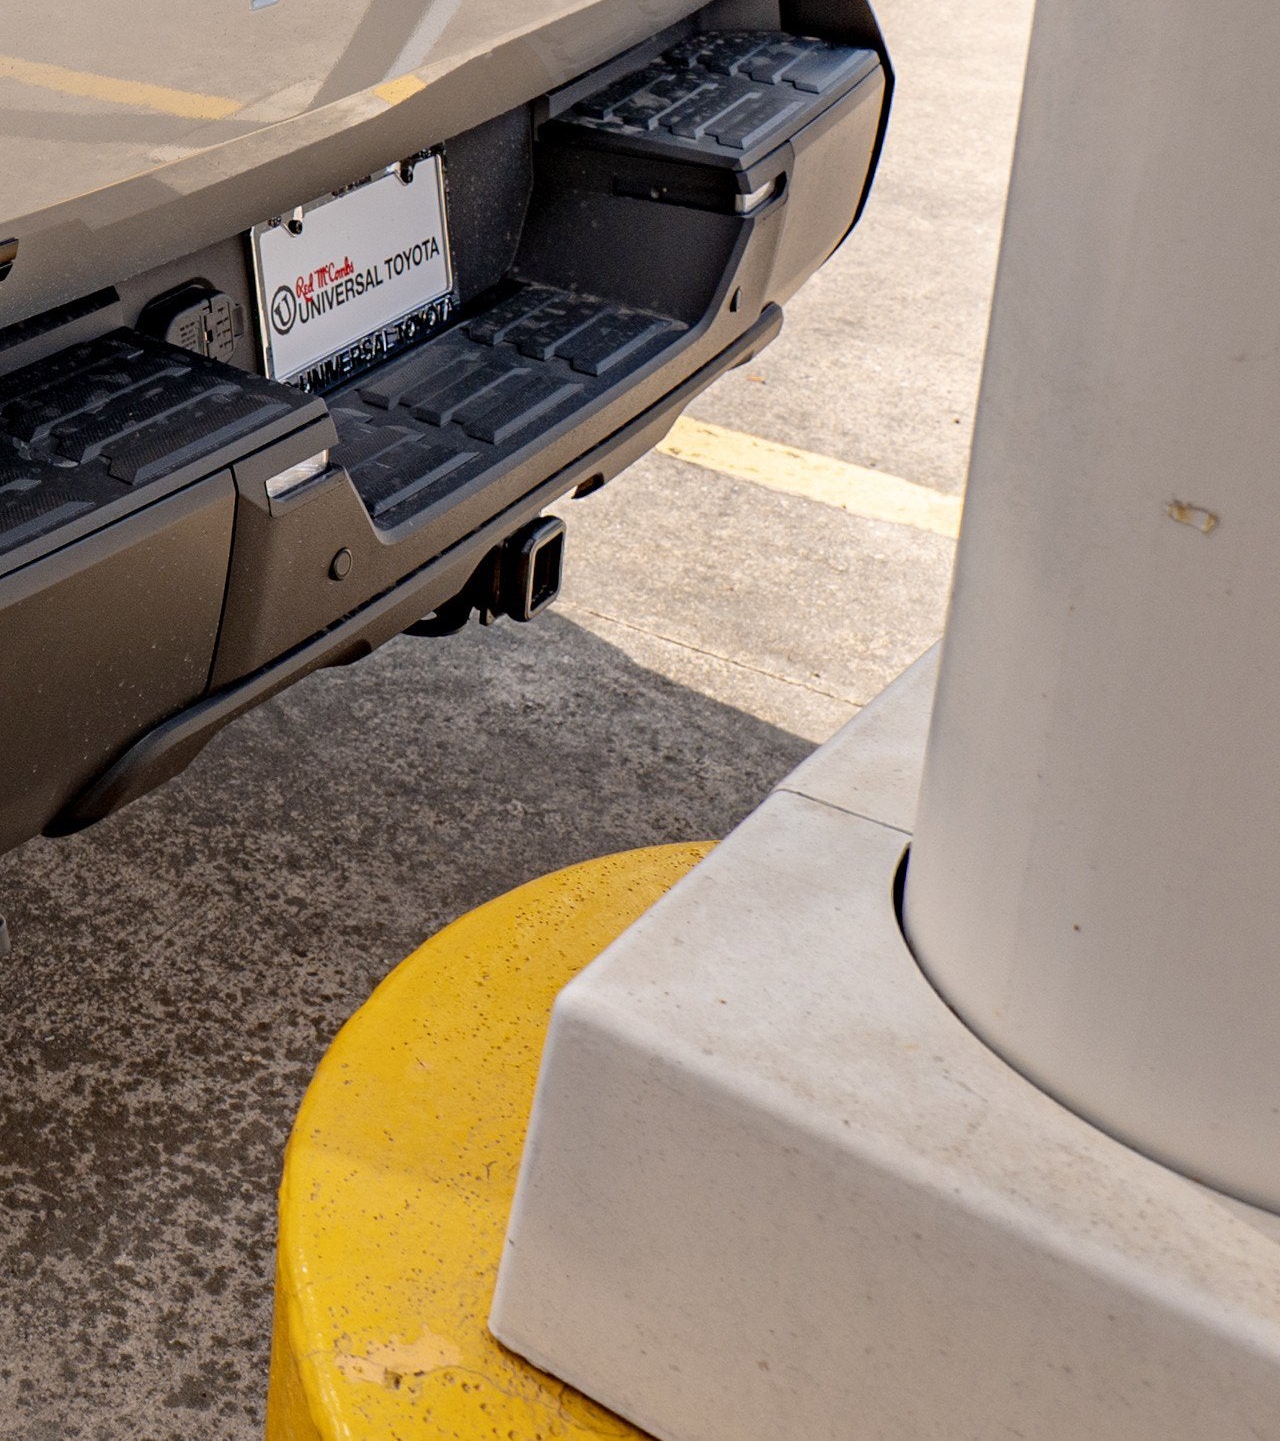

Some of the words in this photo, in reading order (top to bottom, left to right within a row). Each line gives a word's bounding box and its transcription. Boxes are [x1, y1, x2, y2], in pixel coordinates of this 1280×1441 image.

[295, 271, 315, 303] Red
[297, 266, 384, 324] UNIVERSAL
[384, 235, 440, 280] TOYOTA
